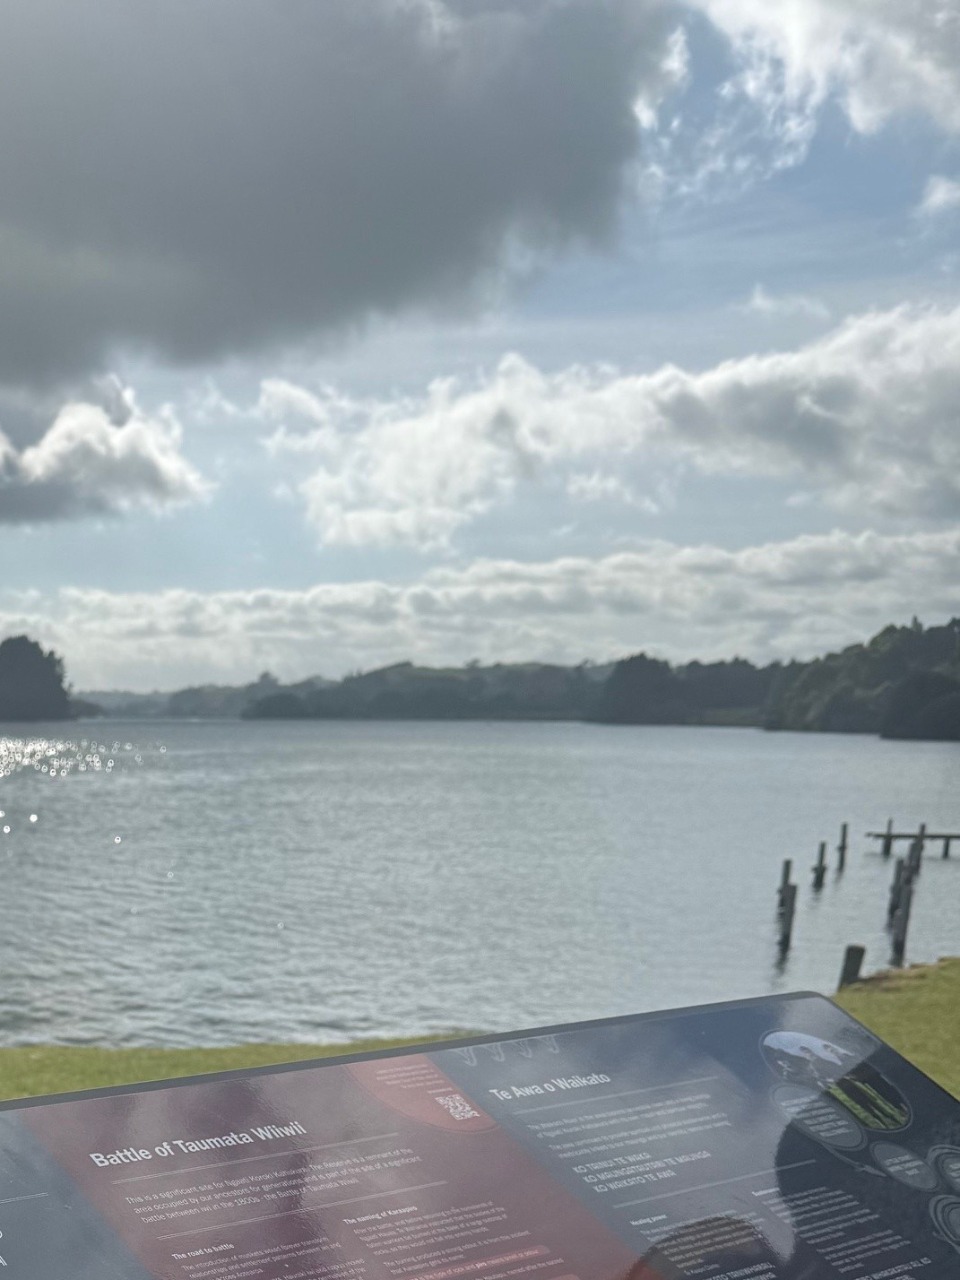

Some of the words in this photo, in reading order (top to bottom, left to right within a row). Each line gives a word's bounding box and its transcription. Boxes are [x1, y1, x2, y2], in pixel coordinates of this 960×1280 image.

[488, 1089, 512, 1100] Te
[510, 1085, 545, 1098] Awa
[543, 1083, 556, 1092] o
[551, 1073, 611, 1090] Waikato
[89, 1147, 152, 1167] Battle
[154, 1142, 175, 1157] of
[172, 1132, 254, 1153] Taumata
[250, 1121, 307, 1140] Wiiwii
[187, 1249, 205, 1257] road
[212, 1243, 235, 1252] battle
